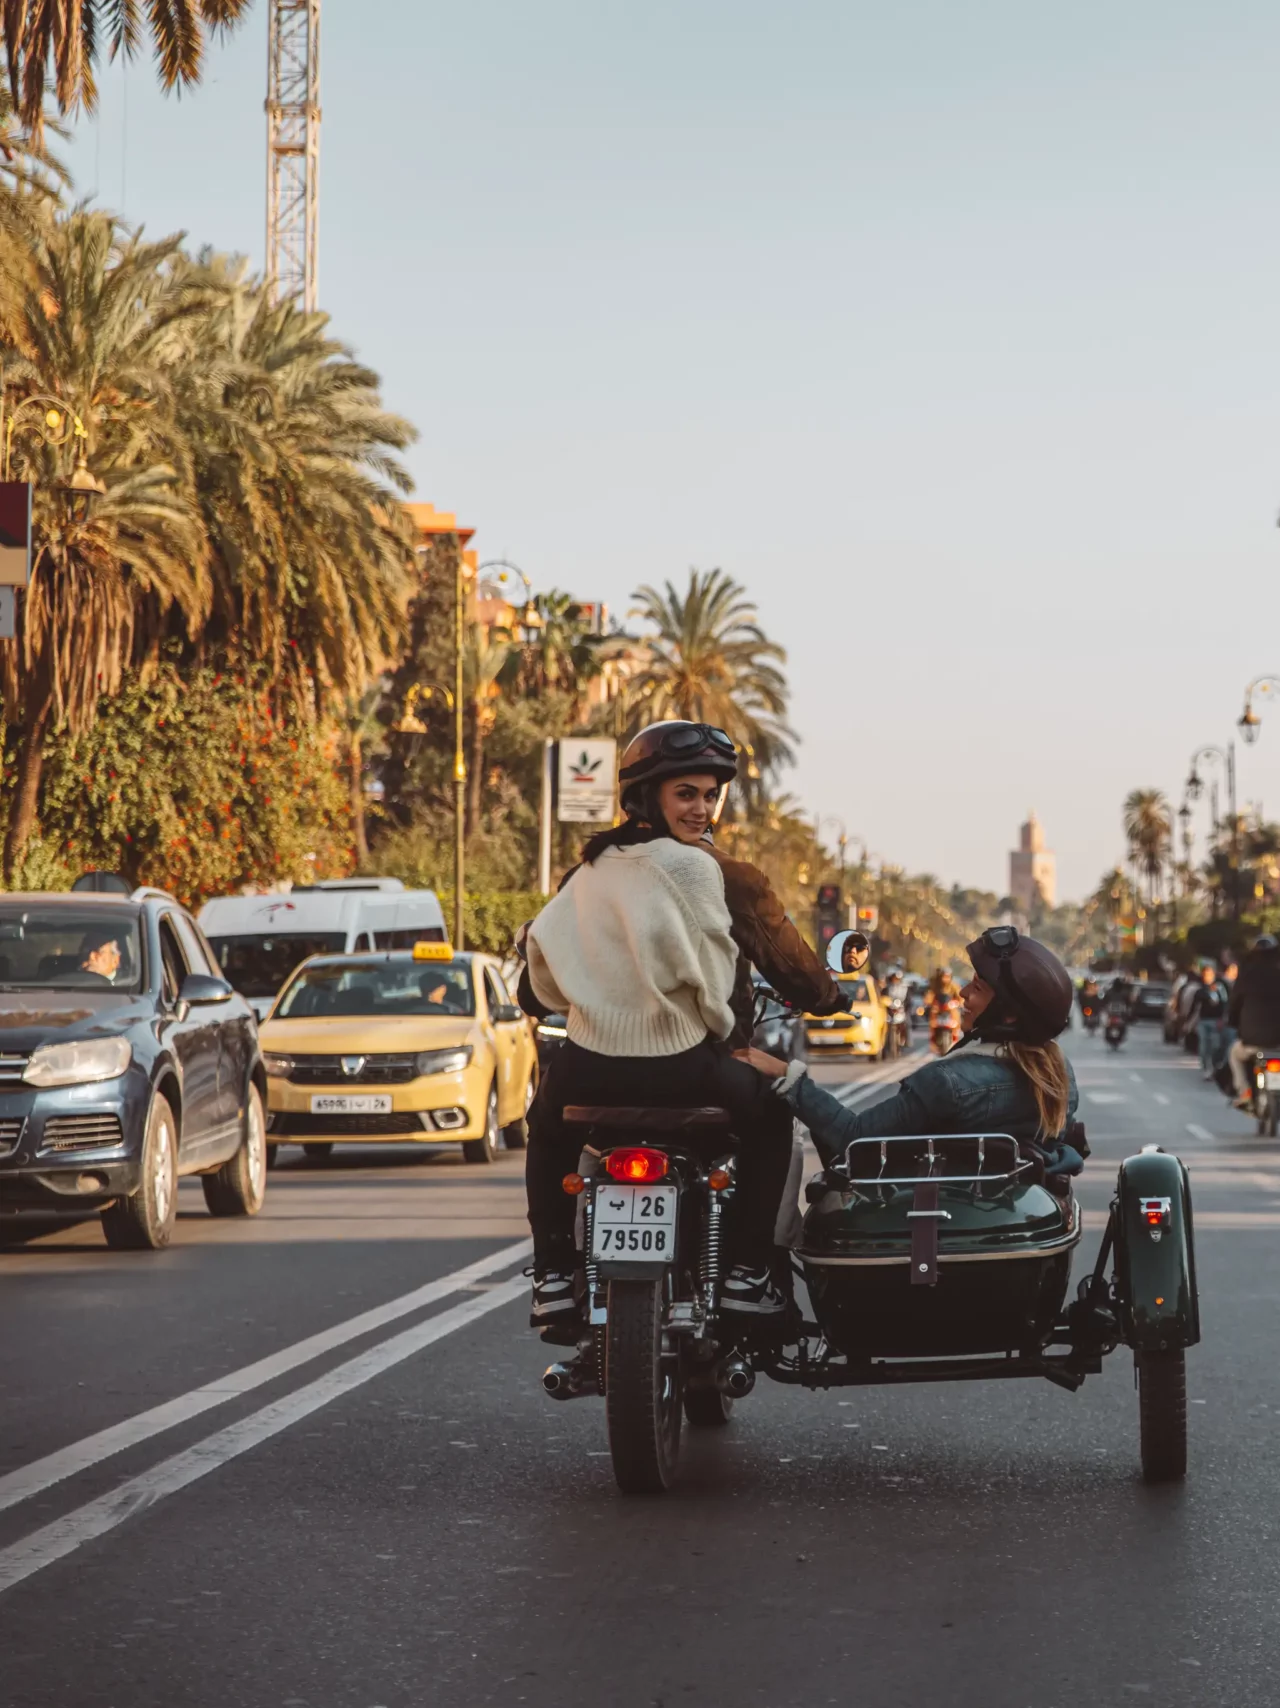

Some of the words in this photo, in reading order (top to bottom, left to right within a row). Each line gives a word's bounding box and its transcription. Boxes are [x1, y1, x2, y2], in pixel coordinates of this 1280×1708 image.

[609, 1199, 625, 1211] ب
[640, 1195, 665, 1217] 26
[601, 1229, 667, 1252] 79508
